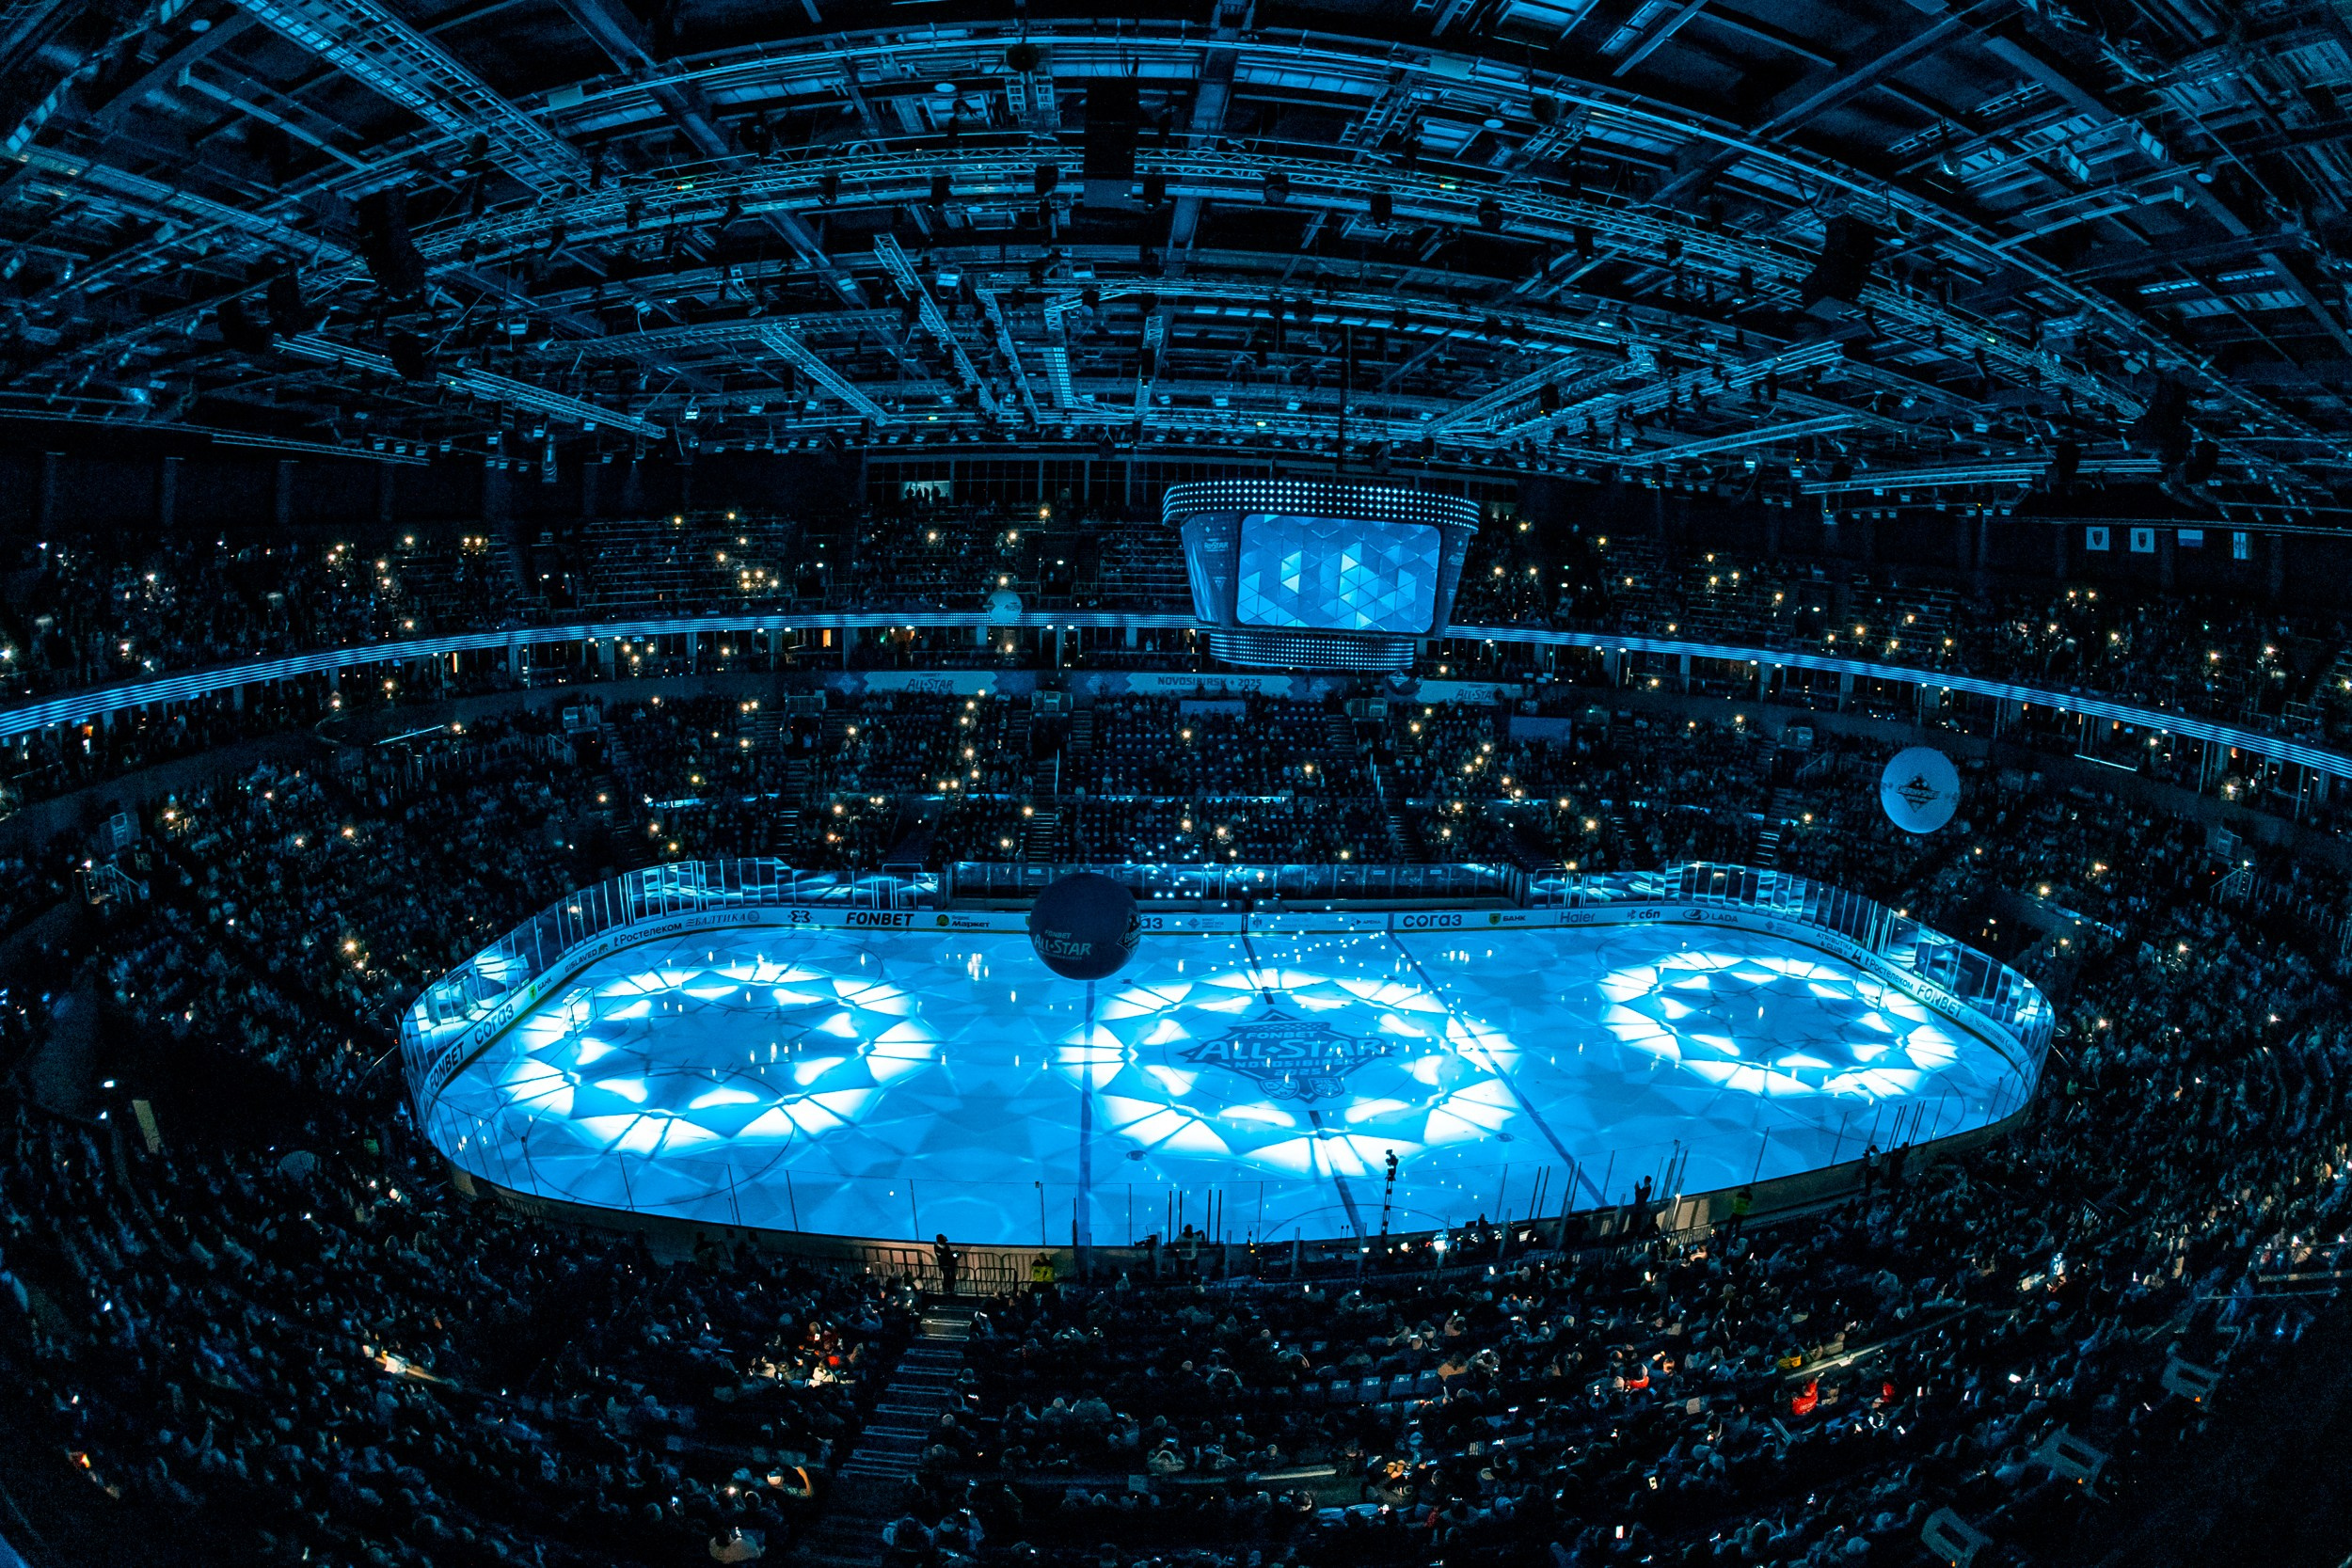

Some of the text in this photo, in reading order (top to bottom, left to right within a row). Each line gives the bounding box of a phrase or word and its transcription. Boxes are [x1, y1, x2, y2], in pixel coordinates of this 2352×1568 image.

[1158, 677, 1262, 687] NOVOSIBIRSK 2025
[695, 913, 746, 926] БАЛТИКА
[847, 911, 914, 927] FONBET
[1560, 911, 1596, 923] Haier
[1711, 913, 1739, 923] LADA
[620, 923, 682, 944] Ростелеком
[1044, 929, 1072, 940] FONBET
[1816, 932, 1852, 950] ATRIBUTIKA
[564, 950, 596, 974] GISLAVED
[1869, 959, 1914, 990] Ростелеком
[537, 976, 553, 992] БАНК
[1916, 984, 1965, 1018] FONBET
[1246, 1030, 1317, 1039] FONBET
[429, 1041, 466, 1089] FONBET
[1234, 1058, 1359, 1069] NOVOSIBIRSK
[1274, 1068, 1321, 1076] 2025
